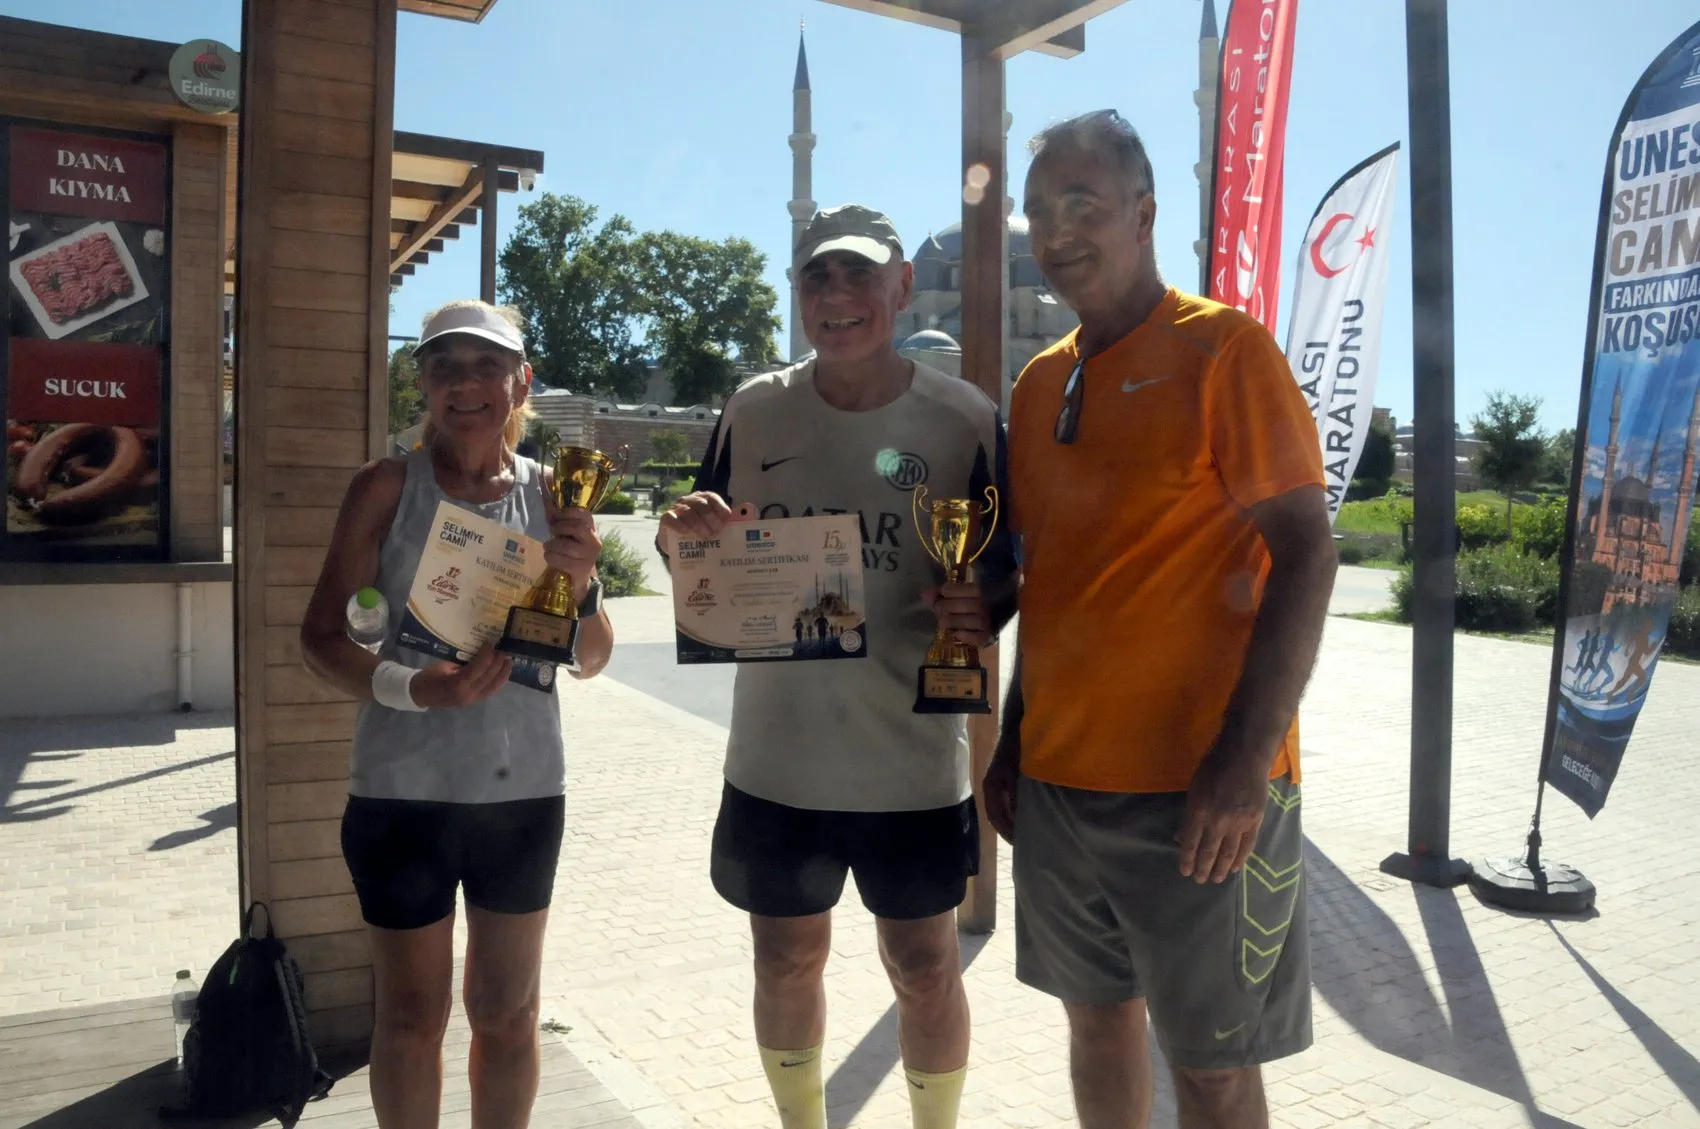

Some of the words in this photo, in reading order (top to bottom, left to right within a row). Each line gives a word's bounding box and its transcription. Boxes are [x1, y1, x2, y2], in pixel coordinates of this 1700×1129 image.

[181, 79, 237, 100] Edirne
[1242, 0, 1276, 203] Marato
[57, 148, 126, 174] DANA
[1215, 47, 1243, 298] ARARASI
[49, 177, 132, 203] KIYMA
[1611, 274, 1700, 310] FARKINDA
[44, 377, 127, 399] SUCUK
[1325, 298, 1364, 513] MARATONU
